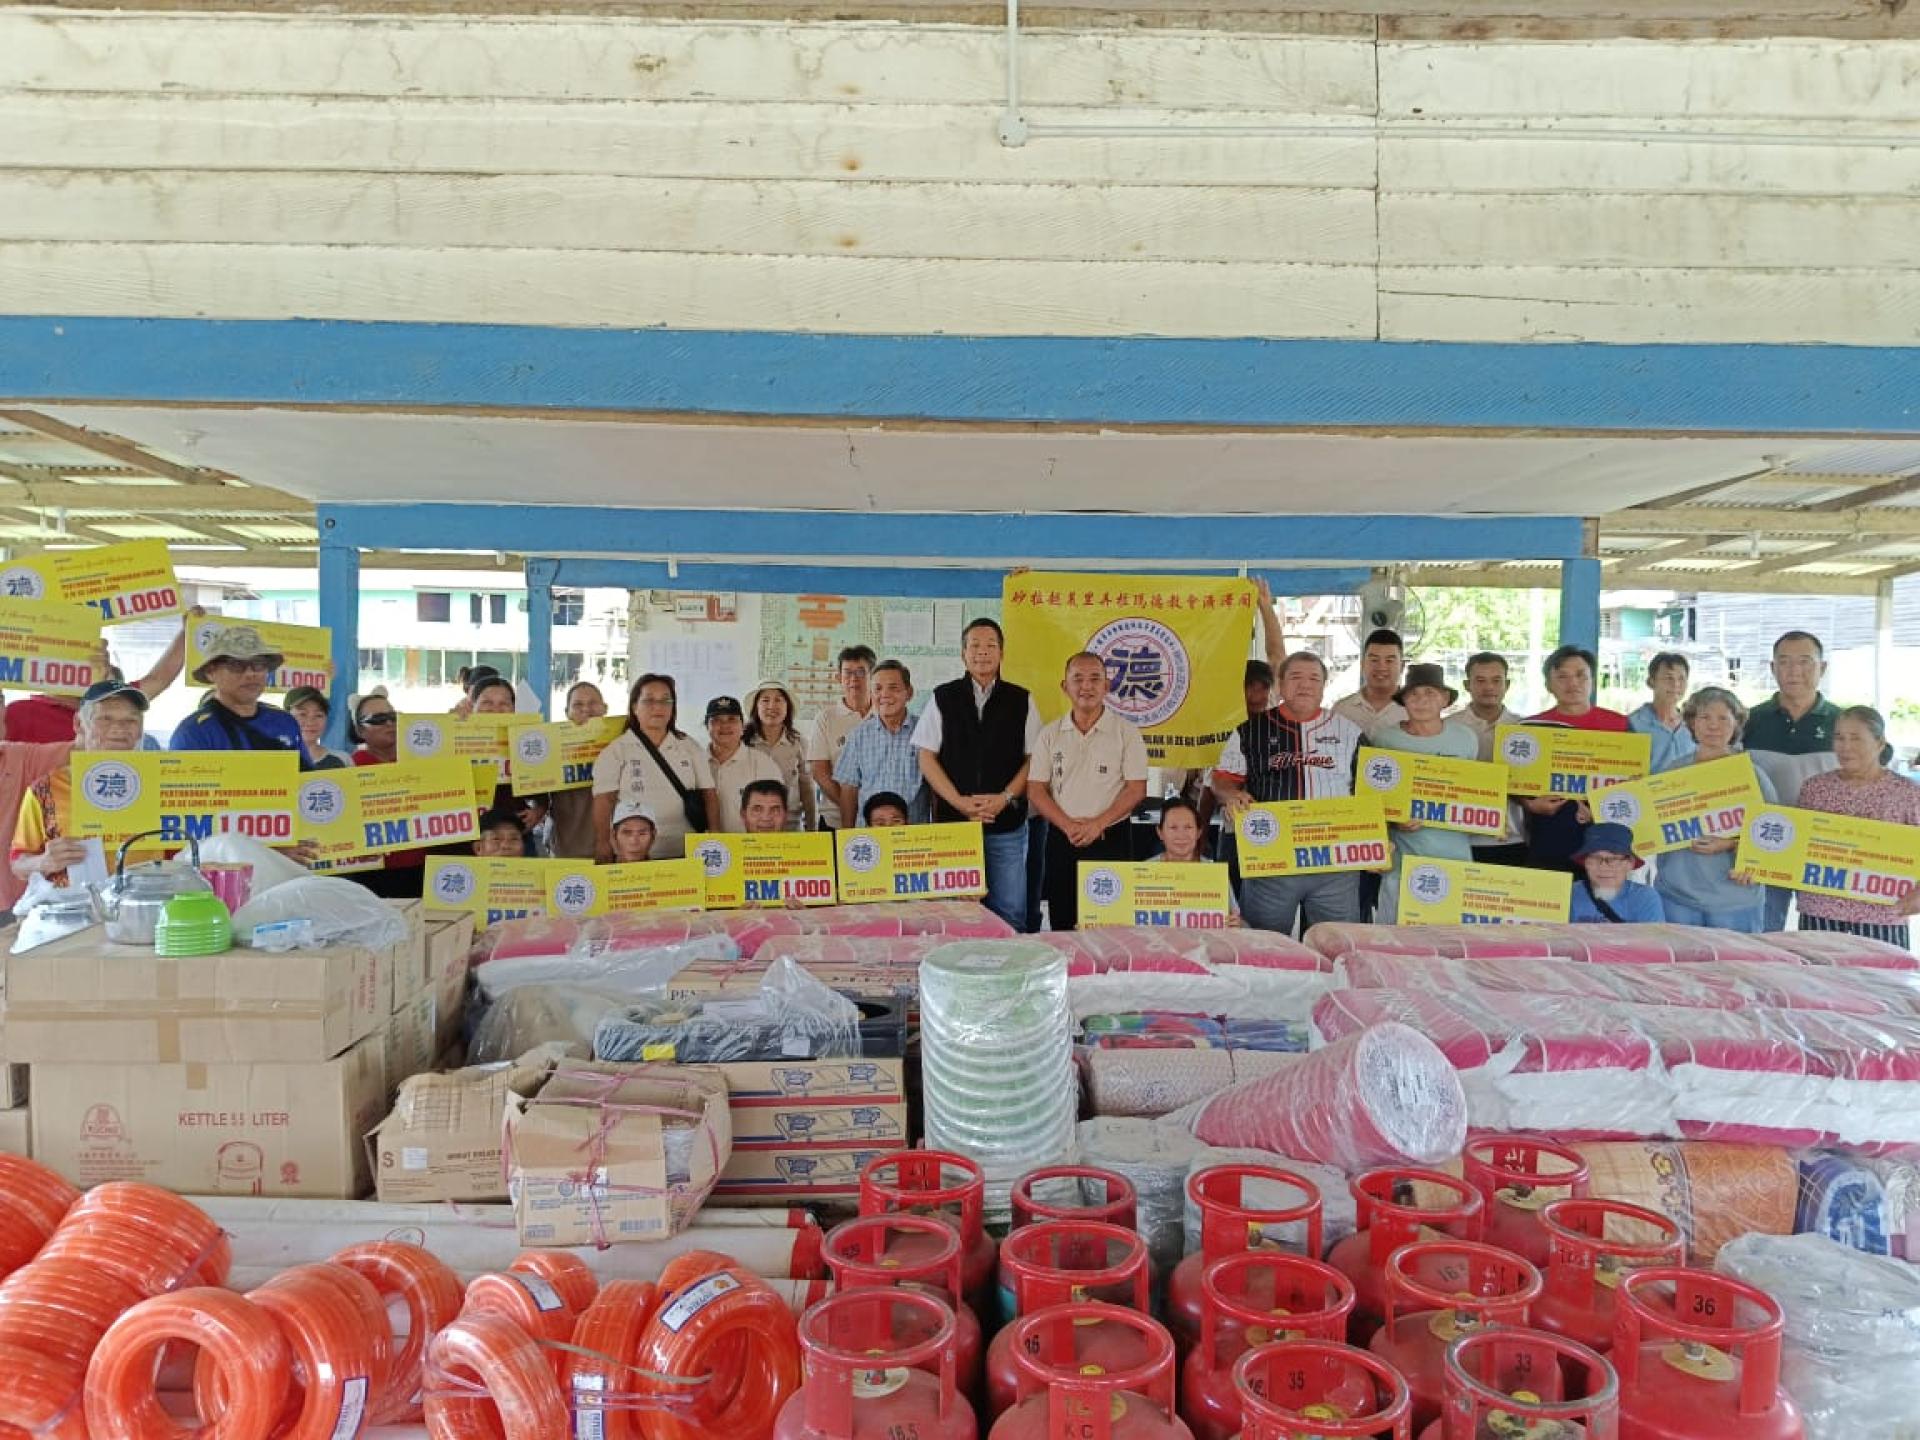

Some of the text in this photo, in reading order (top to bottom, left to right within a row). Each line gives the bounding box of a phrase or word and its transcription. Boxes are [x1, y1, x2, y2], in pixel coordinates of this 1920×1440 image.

[116, 588, 177, 616] 1,000
[31, 660, 92, 687] 1,000
[1550, 773, 1587, 794] RM
[1411, 800, 1448, 823] RM
[1451, 804, 1501, 829] 1,000
[1661, 807, 1746, 844] RM 1,00
[160, 814, 213, 841] RM
[219, 814, 291, 837] 1000
[364, 811, 473, 848] RM 1,000
[1294, 843, 1385, 868] RM 1,000
[745, 879, 779, 900] RM
[783, 879, 831, 898] 1,000
[894, 870, 981, 894] RM 1,000
[1802, 862, 1914, 899] RM 1,000
[1134, 910, 1224, 928] RM 1000
[178, 1112, 227, 1127] KETTLE
[252, 1112, 289, 1127] LITER
[382, 1151, 395, 1169] S
[1693, 1294, 1716, 1316] 36
